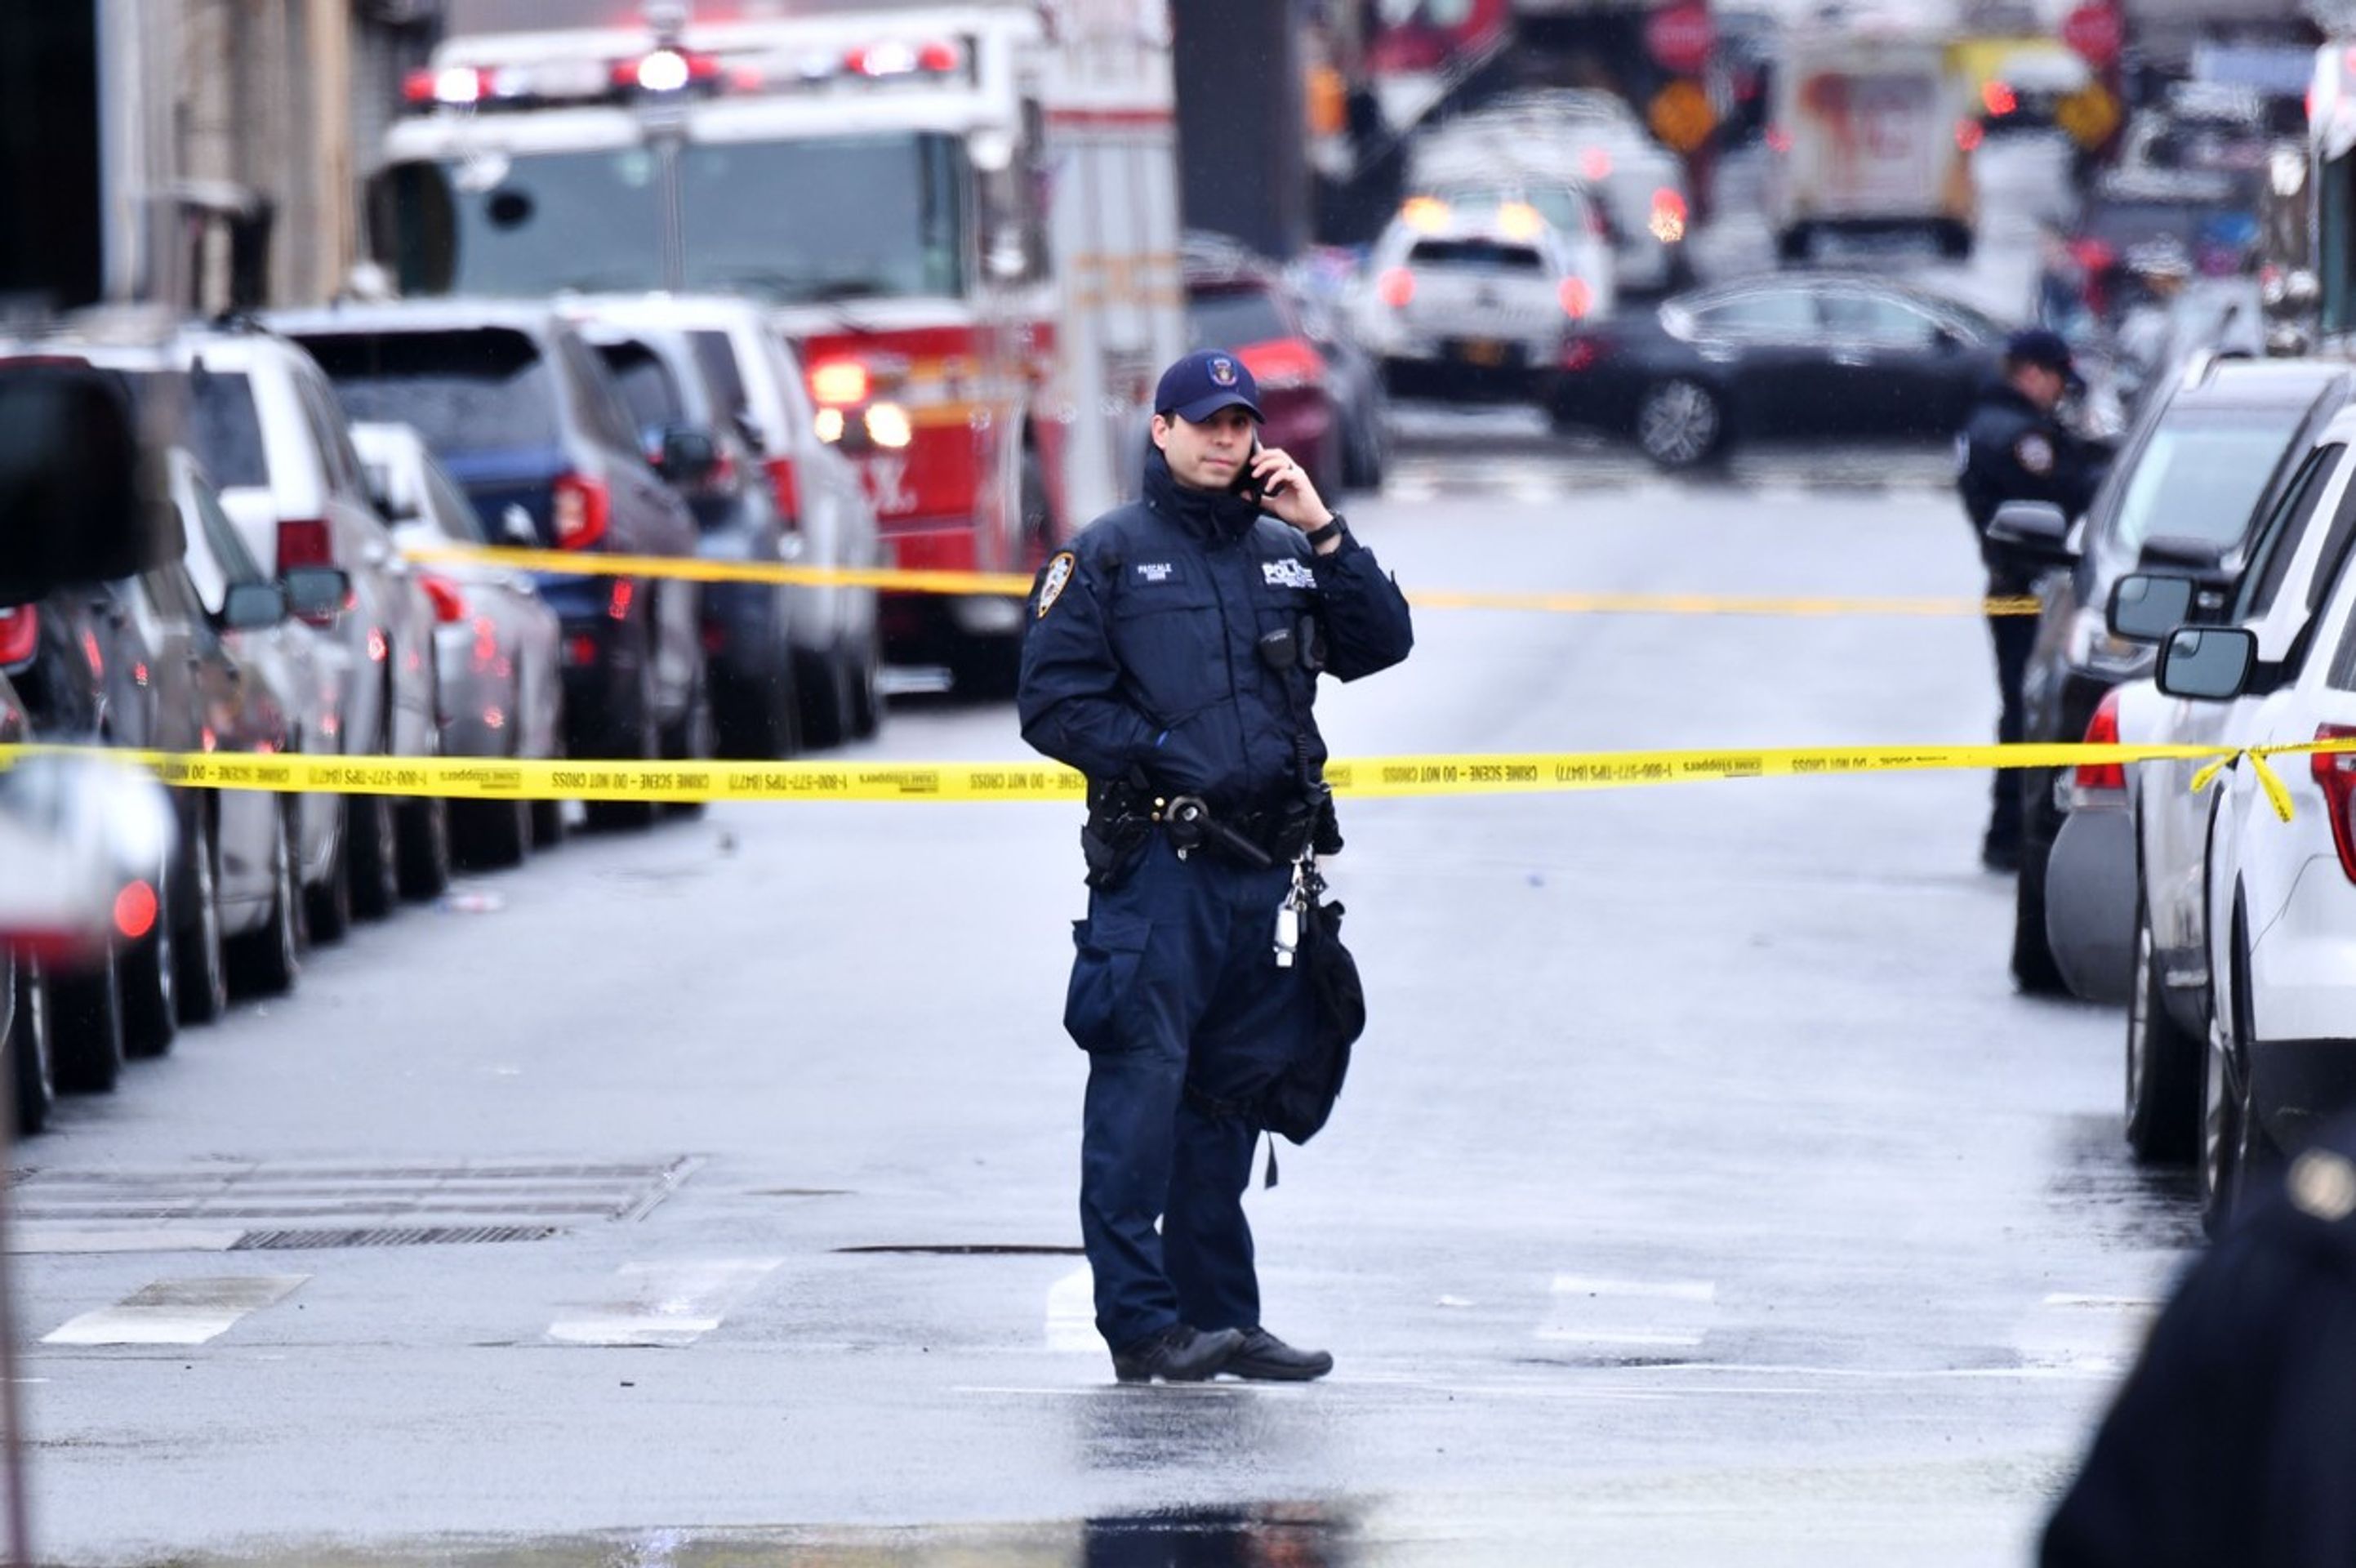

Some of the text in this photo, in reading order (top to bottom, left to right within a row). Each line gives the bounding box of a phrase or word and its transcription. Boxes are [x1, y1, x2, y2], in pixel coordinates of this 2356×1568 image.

[192, 764, 205, 780] DO
[551, 771, 586, 789] CROSS
[1420, 765, 1441, 783] NOT
[1443, 765, 1457, 782] DO
[1470, 764, 1502, 782] SCENE
[1505, 764, 1537, 782] CRIME
[590, 773, 610, 790] NOT
[613, 773, 628, 790] DO
[639, 773, 672, 790] SCENE
[676, 773, 710, 790] CRIME
[970, 773, 1004, 790] CROSS
[1008, 773, 1027, 790] NOT
[1030, 773, 1044, 790] DO
[1057, 773, 1087, 790] CENE
